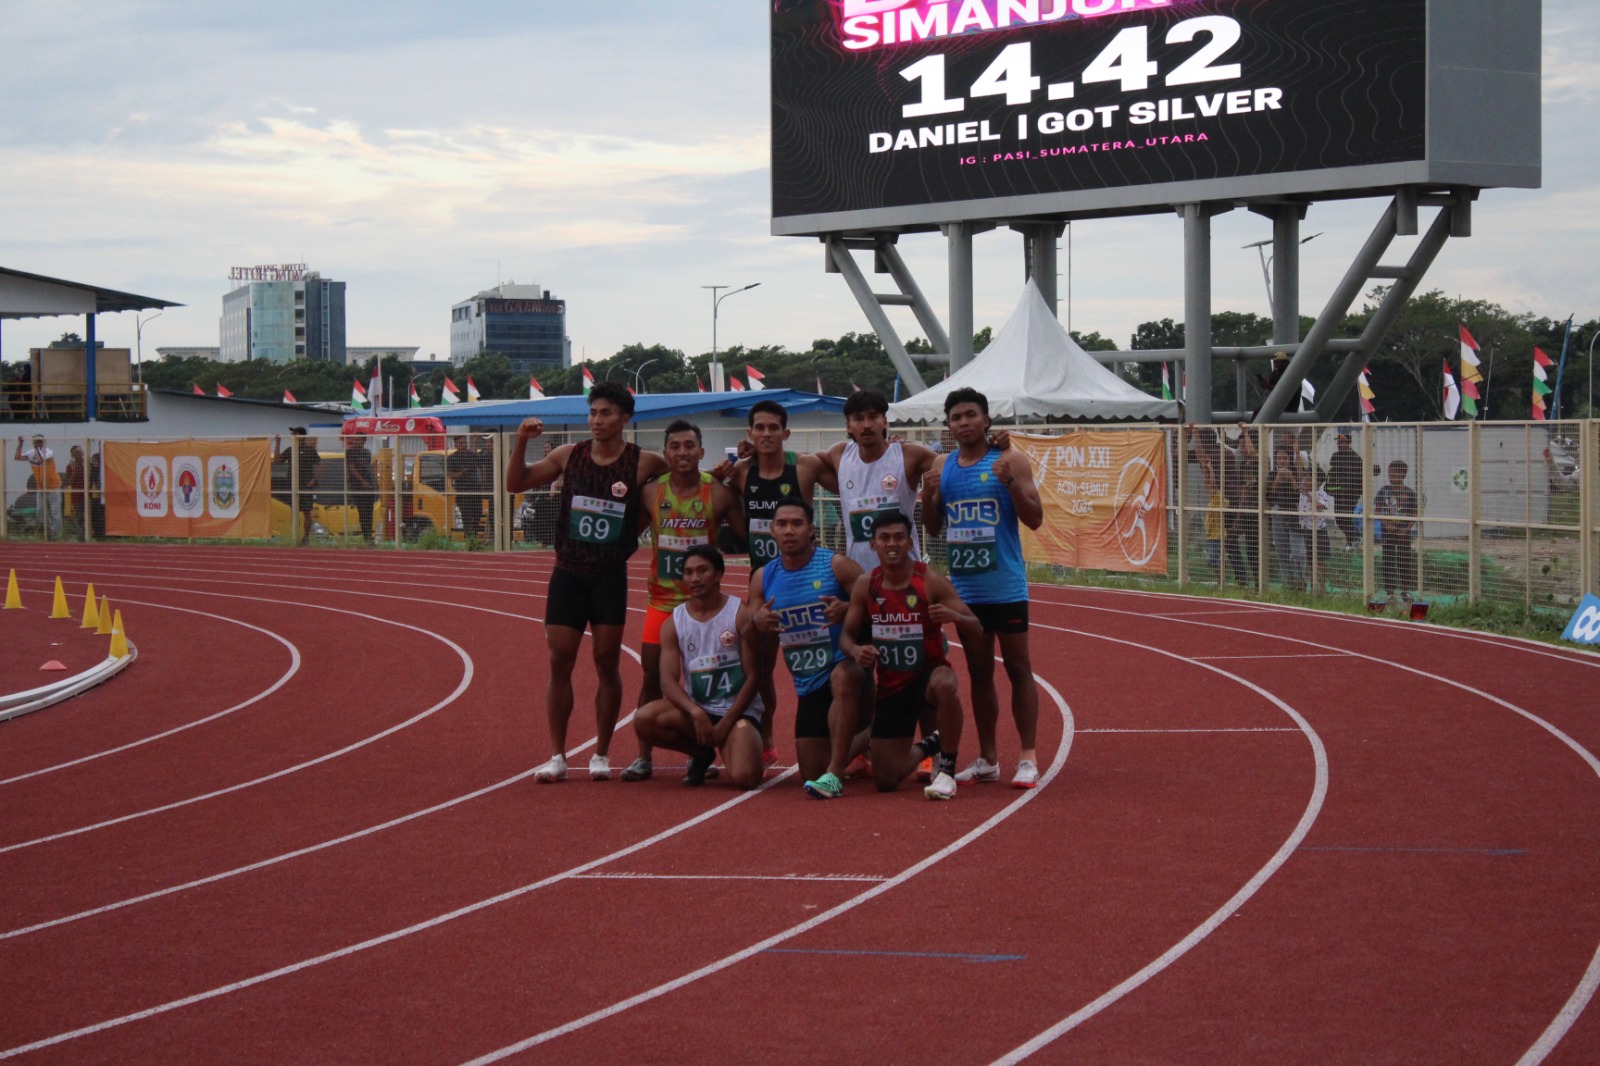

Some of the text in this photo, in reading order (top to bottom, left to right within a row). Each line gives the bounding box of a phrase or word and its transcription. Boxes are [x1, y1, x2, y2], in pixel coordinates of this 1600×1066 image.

[842, 0, 1168, 49] SIMANJ
[898, 15, 1242, 118] 14.42
[869, 87, 1283, 153] DANIEL I GOT SILVER
[959, 156, 976, 165] IG
[993, 132, 1209, 161] PASI_SUMATERA_UTARA
[1056, 446, 1110, 468] PON XXI
[143, 502, 161, 510] KONI
[748, 500, 778, 510] SUM
[946, 499, 999, 526] NTB
[578, 516, 610, 539] 69
[660, 518, 706, 529] JATENG
[951, 548, 991, 568] 223
[777, 601, 830, 630] NTB
[871, 612, 921, 624] SUMUT
[789, 648, 828, 672] 229
[879, 645, 918, 666] 319
[700, 671, 733, 698] 74
